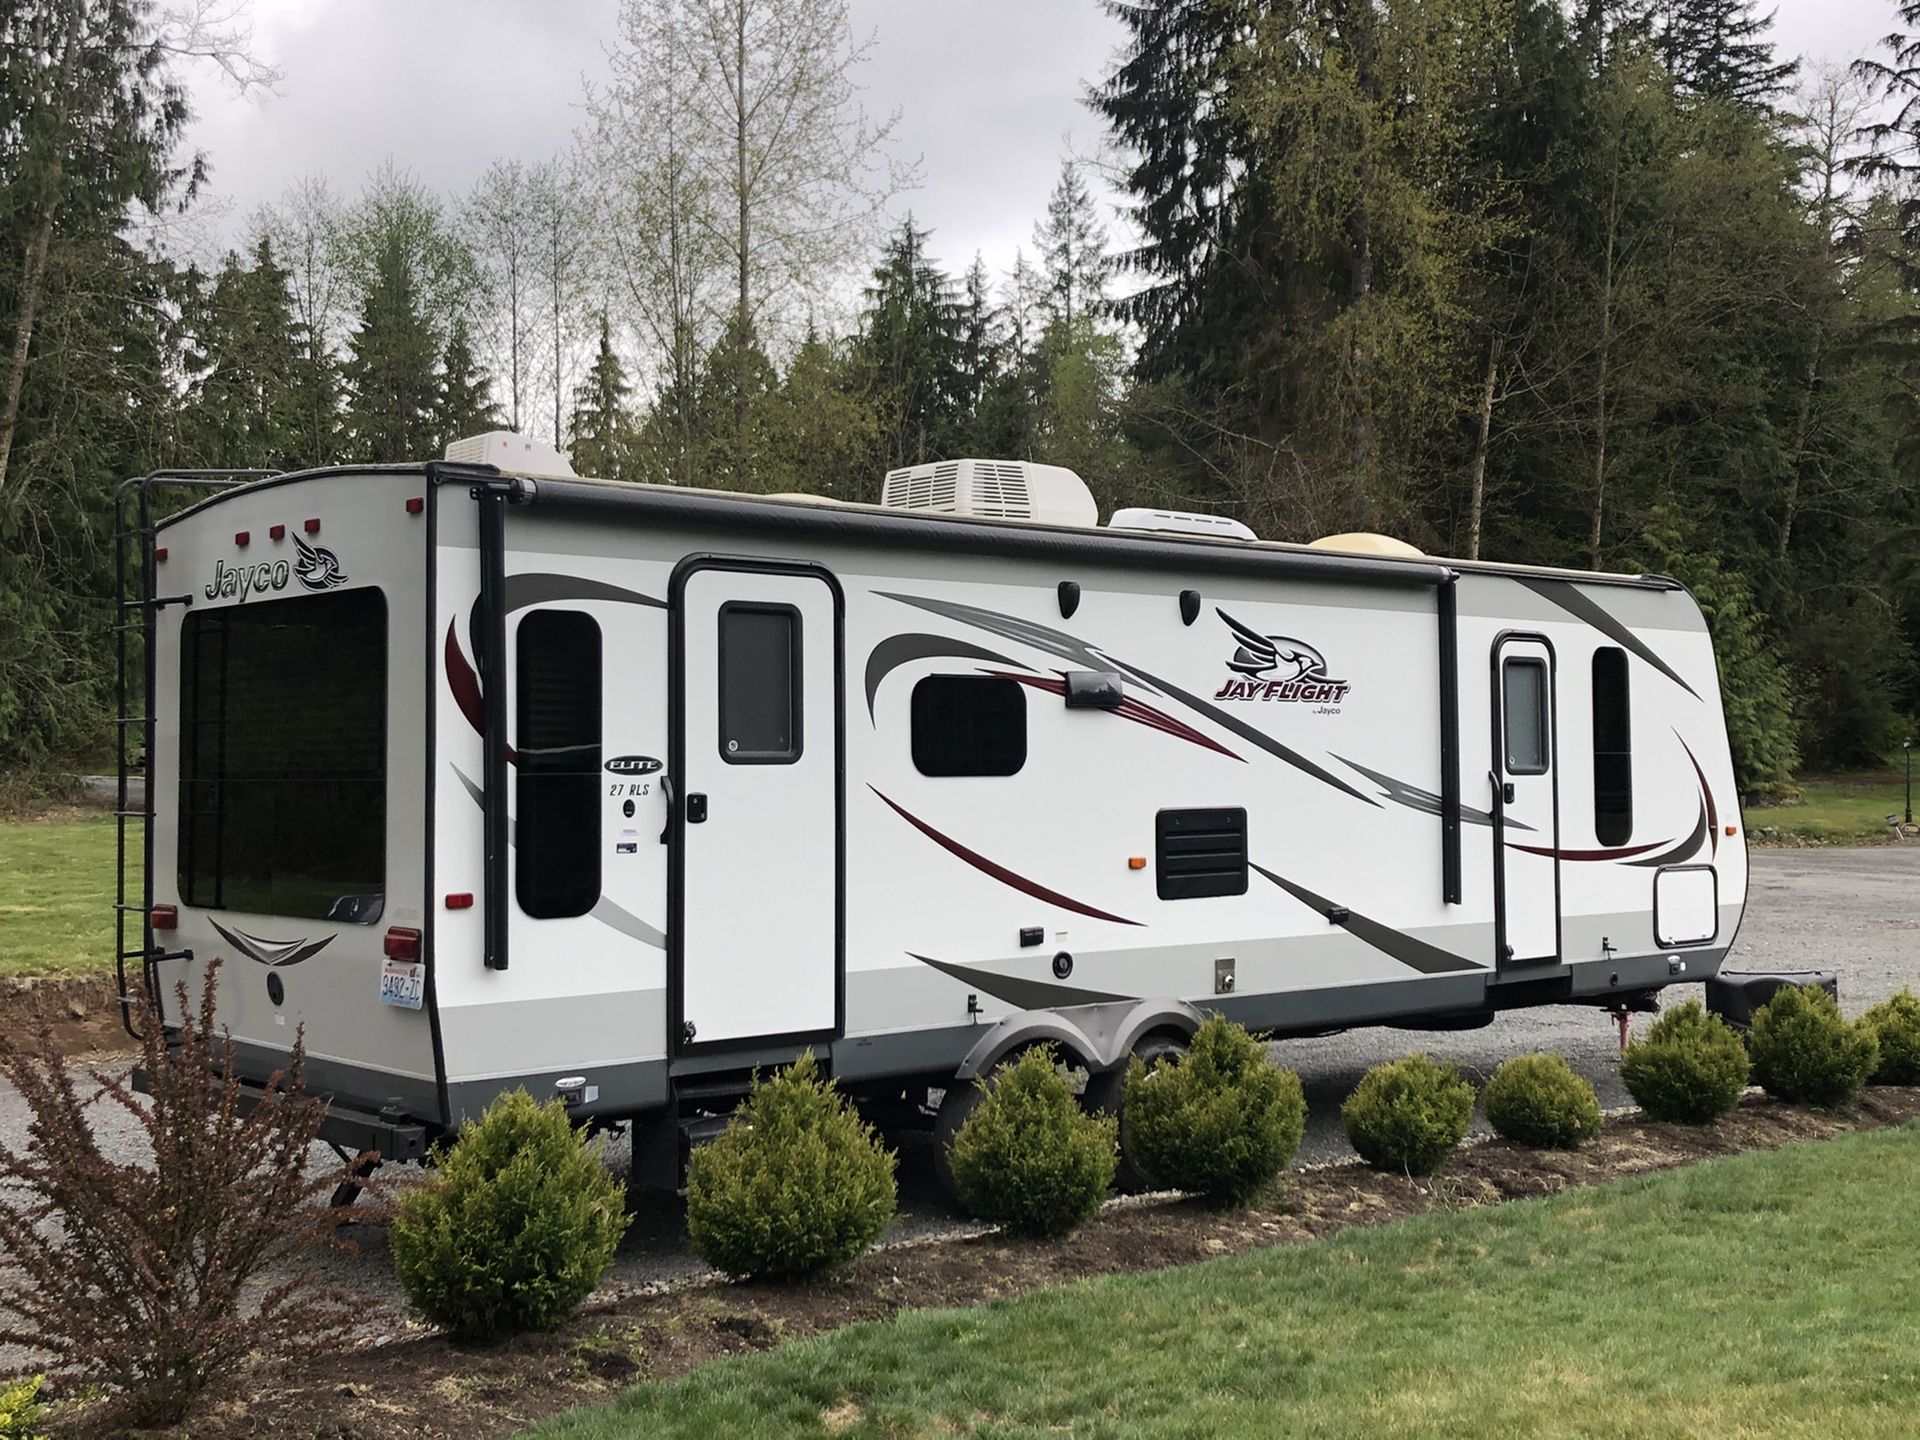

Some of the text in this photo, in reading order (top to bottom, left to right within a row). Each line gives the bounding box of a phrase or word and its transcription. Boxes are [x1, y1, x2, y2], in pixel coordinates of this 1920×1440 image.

[205, 559, 290, 604] Jayco
[1214, 679, 1351, 704] JAY FLIGHT
[1317, 706, 1342, 716] Jayco
[608, 760, 659, 770] ELITE
[609, 783, 650, 797] 27 RLS
